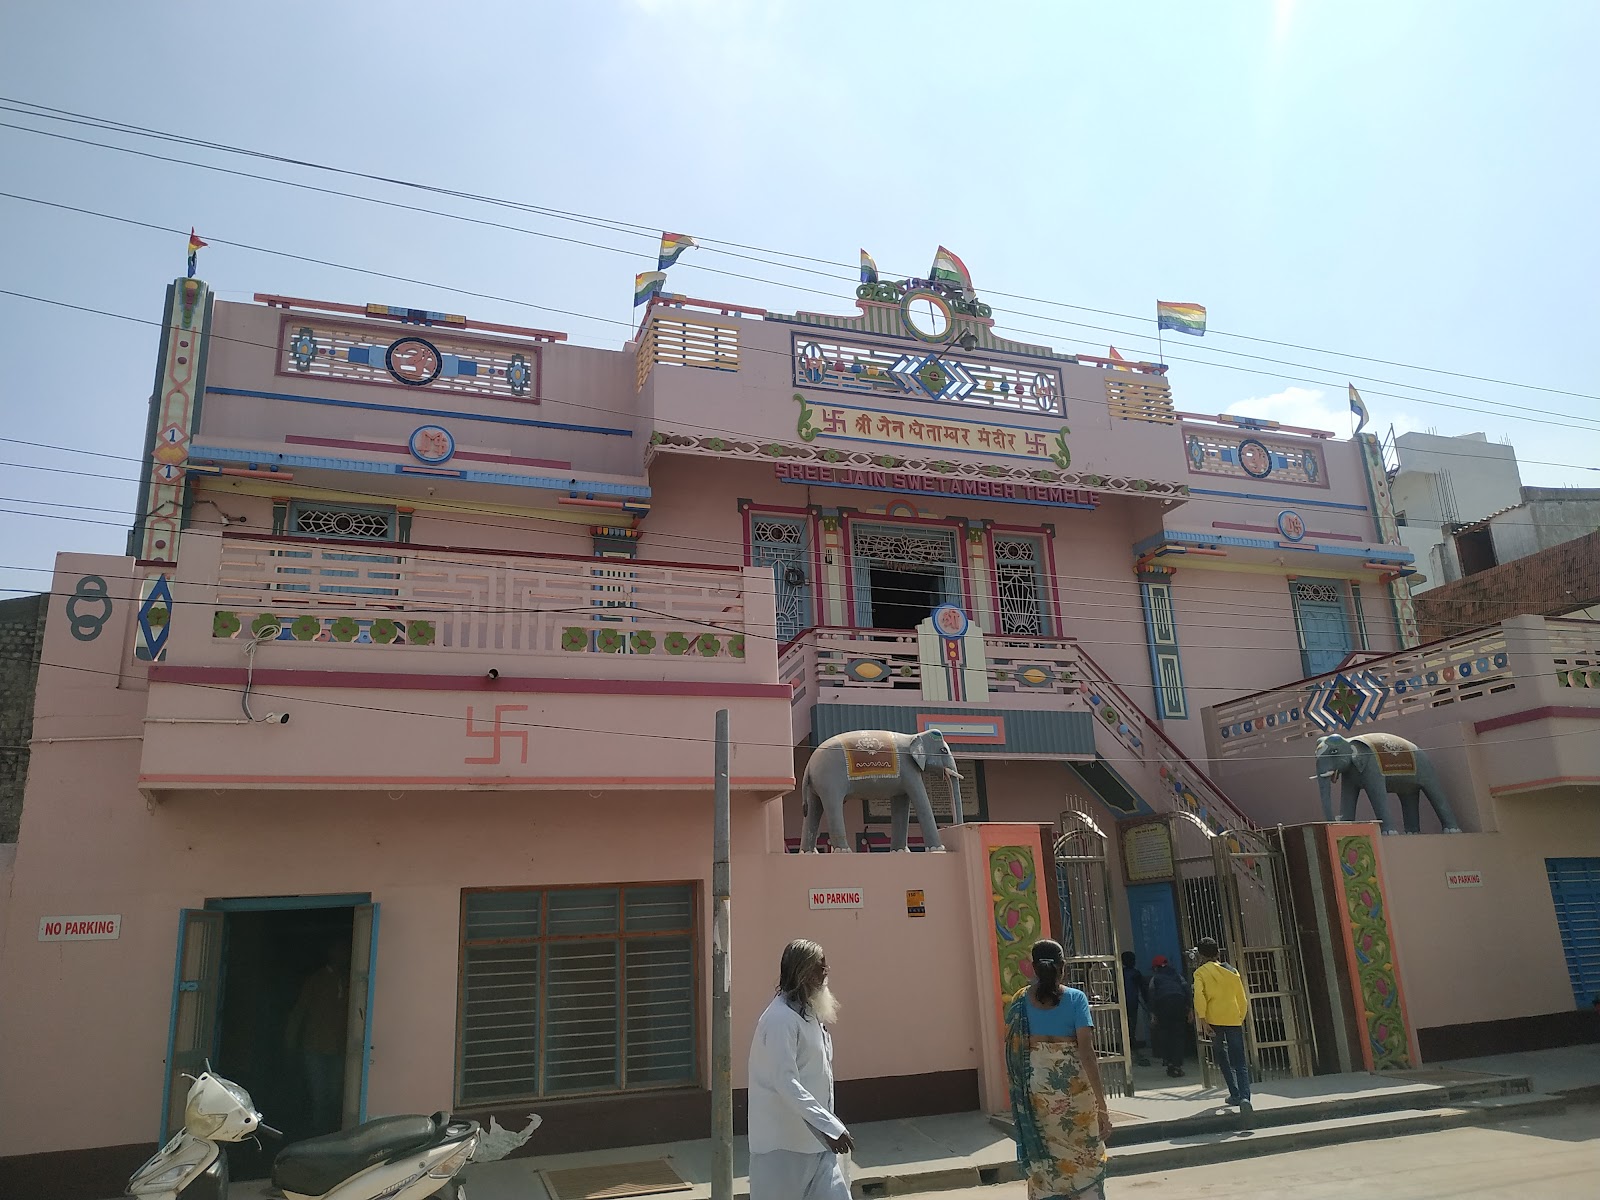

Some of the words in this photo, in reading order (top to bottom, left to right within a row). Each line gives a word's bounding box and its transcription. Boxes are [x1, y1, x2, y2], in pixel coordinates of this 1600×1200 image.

[855, 413, 873, 435] श्री
[977, 427, 1017, 452] मंदीर
[774, 462, 831, 482] SREE
[840, 469, 887, 487] JAIN
[892, 473, 1016, 499] SWETAMBER
[1022, 484, 1101, 506] TEMPLE
[1449, 876, 1458, 884] NO
[1458, 875, 1480, 884] PARKING
[813, 893, 825, 905] NO
[826, 892, 860, 904] PARKING
[45, 922, 62, 936] NO
[65, 921, 114, 935] PARKING
